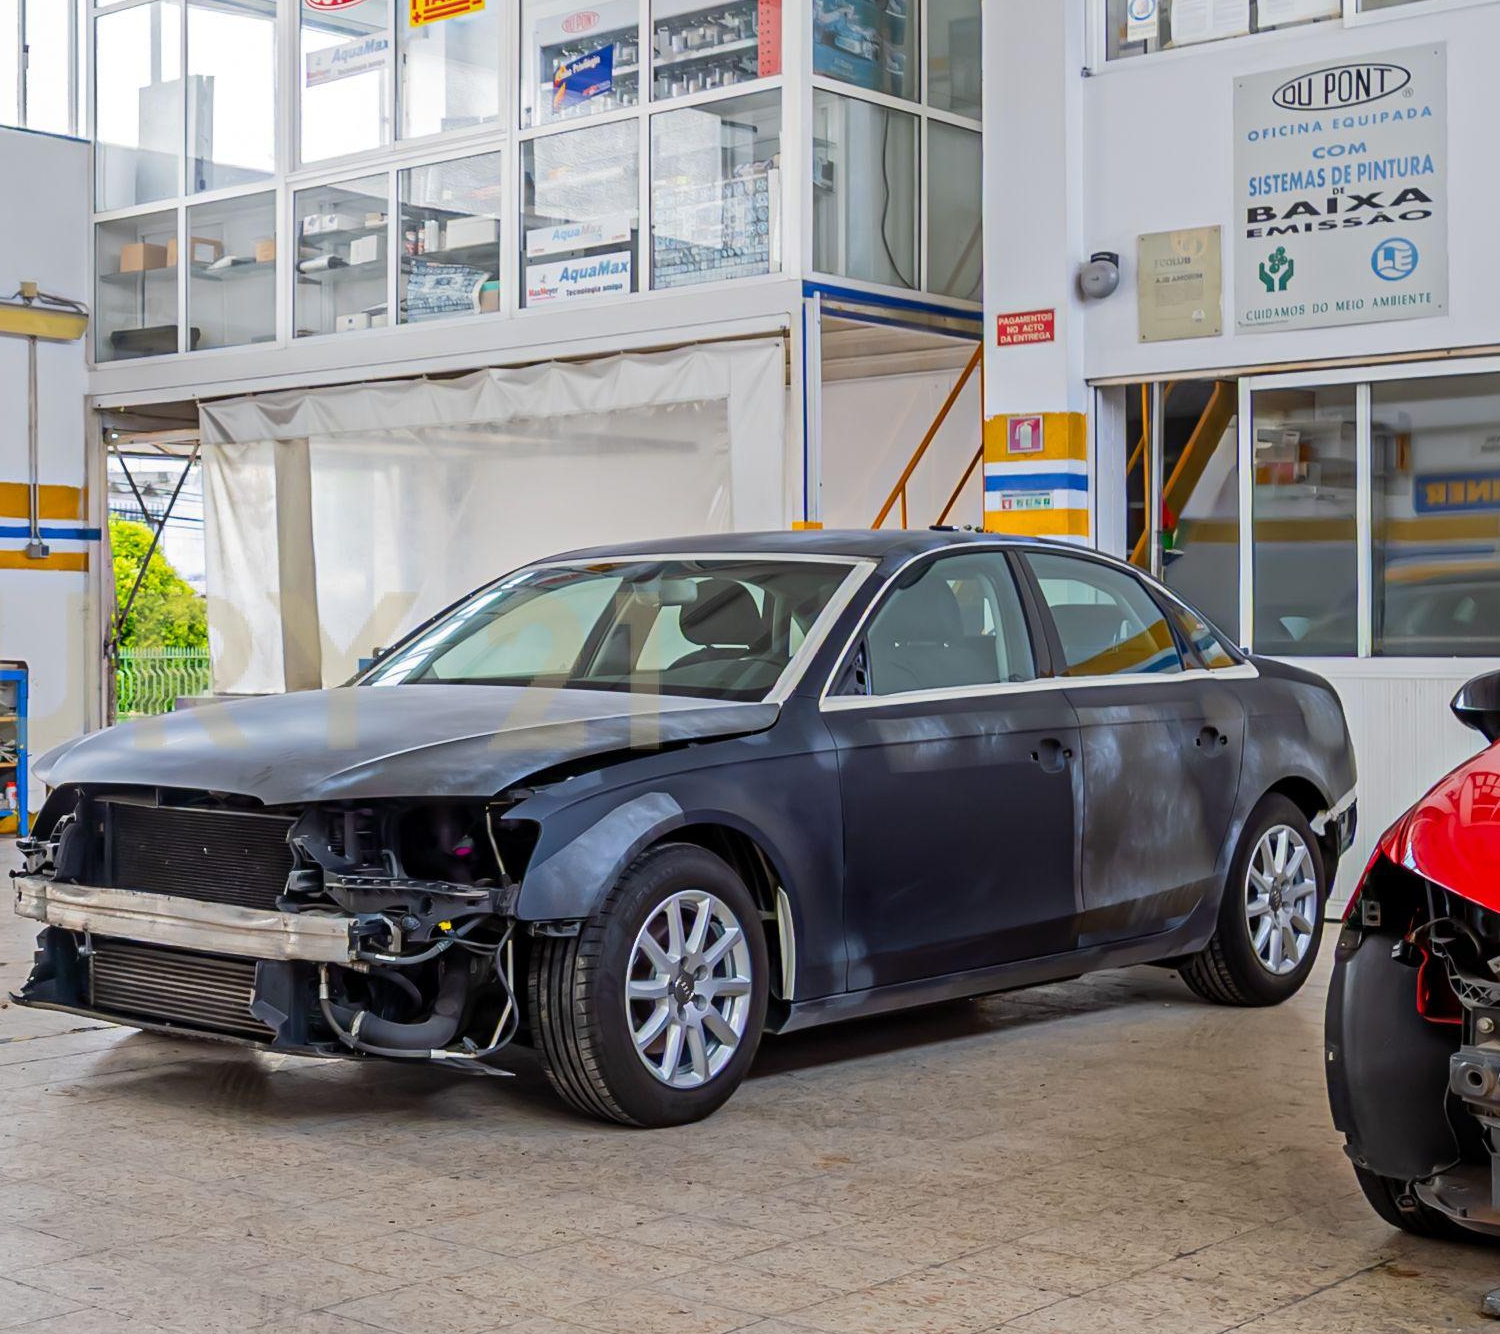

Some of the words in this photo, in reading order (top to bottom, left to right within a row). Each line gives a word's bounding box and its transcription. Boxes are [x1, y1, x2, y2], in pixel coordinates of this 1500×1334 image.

[331, 38, 388, 64] AquaMax
[1281, 78, 1312, 107] DU
[1324, 67, 1393, 105] PONT
[1247, 120, 1323, 143] OFICINA
[1332, 105, 1433, 130] EQUIPADA
[1312, 142, 1367, 159] COM
[1248, 167, 1326, 197] SISTEMAS
[1330, 164, 1352, 186] DE
[1356, 153, 1435, 183] PINTURA
[1332, 187, 1345, 196] DE
[1246, 187, 1434, 224] BAIXA
[551, 224, 603, 242] AquaMax
[1246, 209, 1433, 239] EMISSÃO
[558, 259, 629, 284] AquaMax
[565, 285, 601, 297] Tecnologia
[998, 312, 1053, 326] PAGAMENTOS
[1245, 304, 1306, 322] CUIDAMOS
[1312, 301, 1329, 314] DO
[1335, 298, 1364, 312] MEIO
[1372, 291, 1432, 307] AMBIENTE
[1000, 335, 1012, 344] DA
[1013, 331, 1051, 343] ENTREGA
[1006, 325, 1019, 334] NO
[1022, 323, 1045, 333] ACTO
